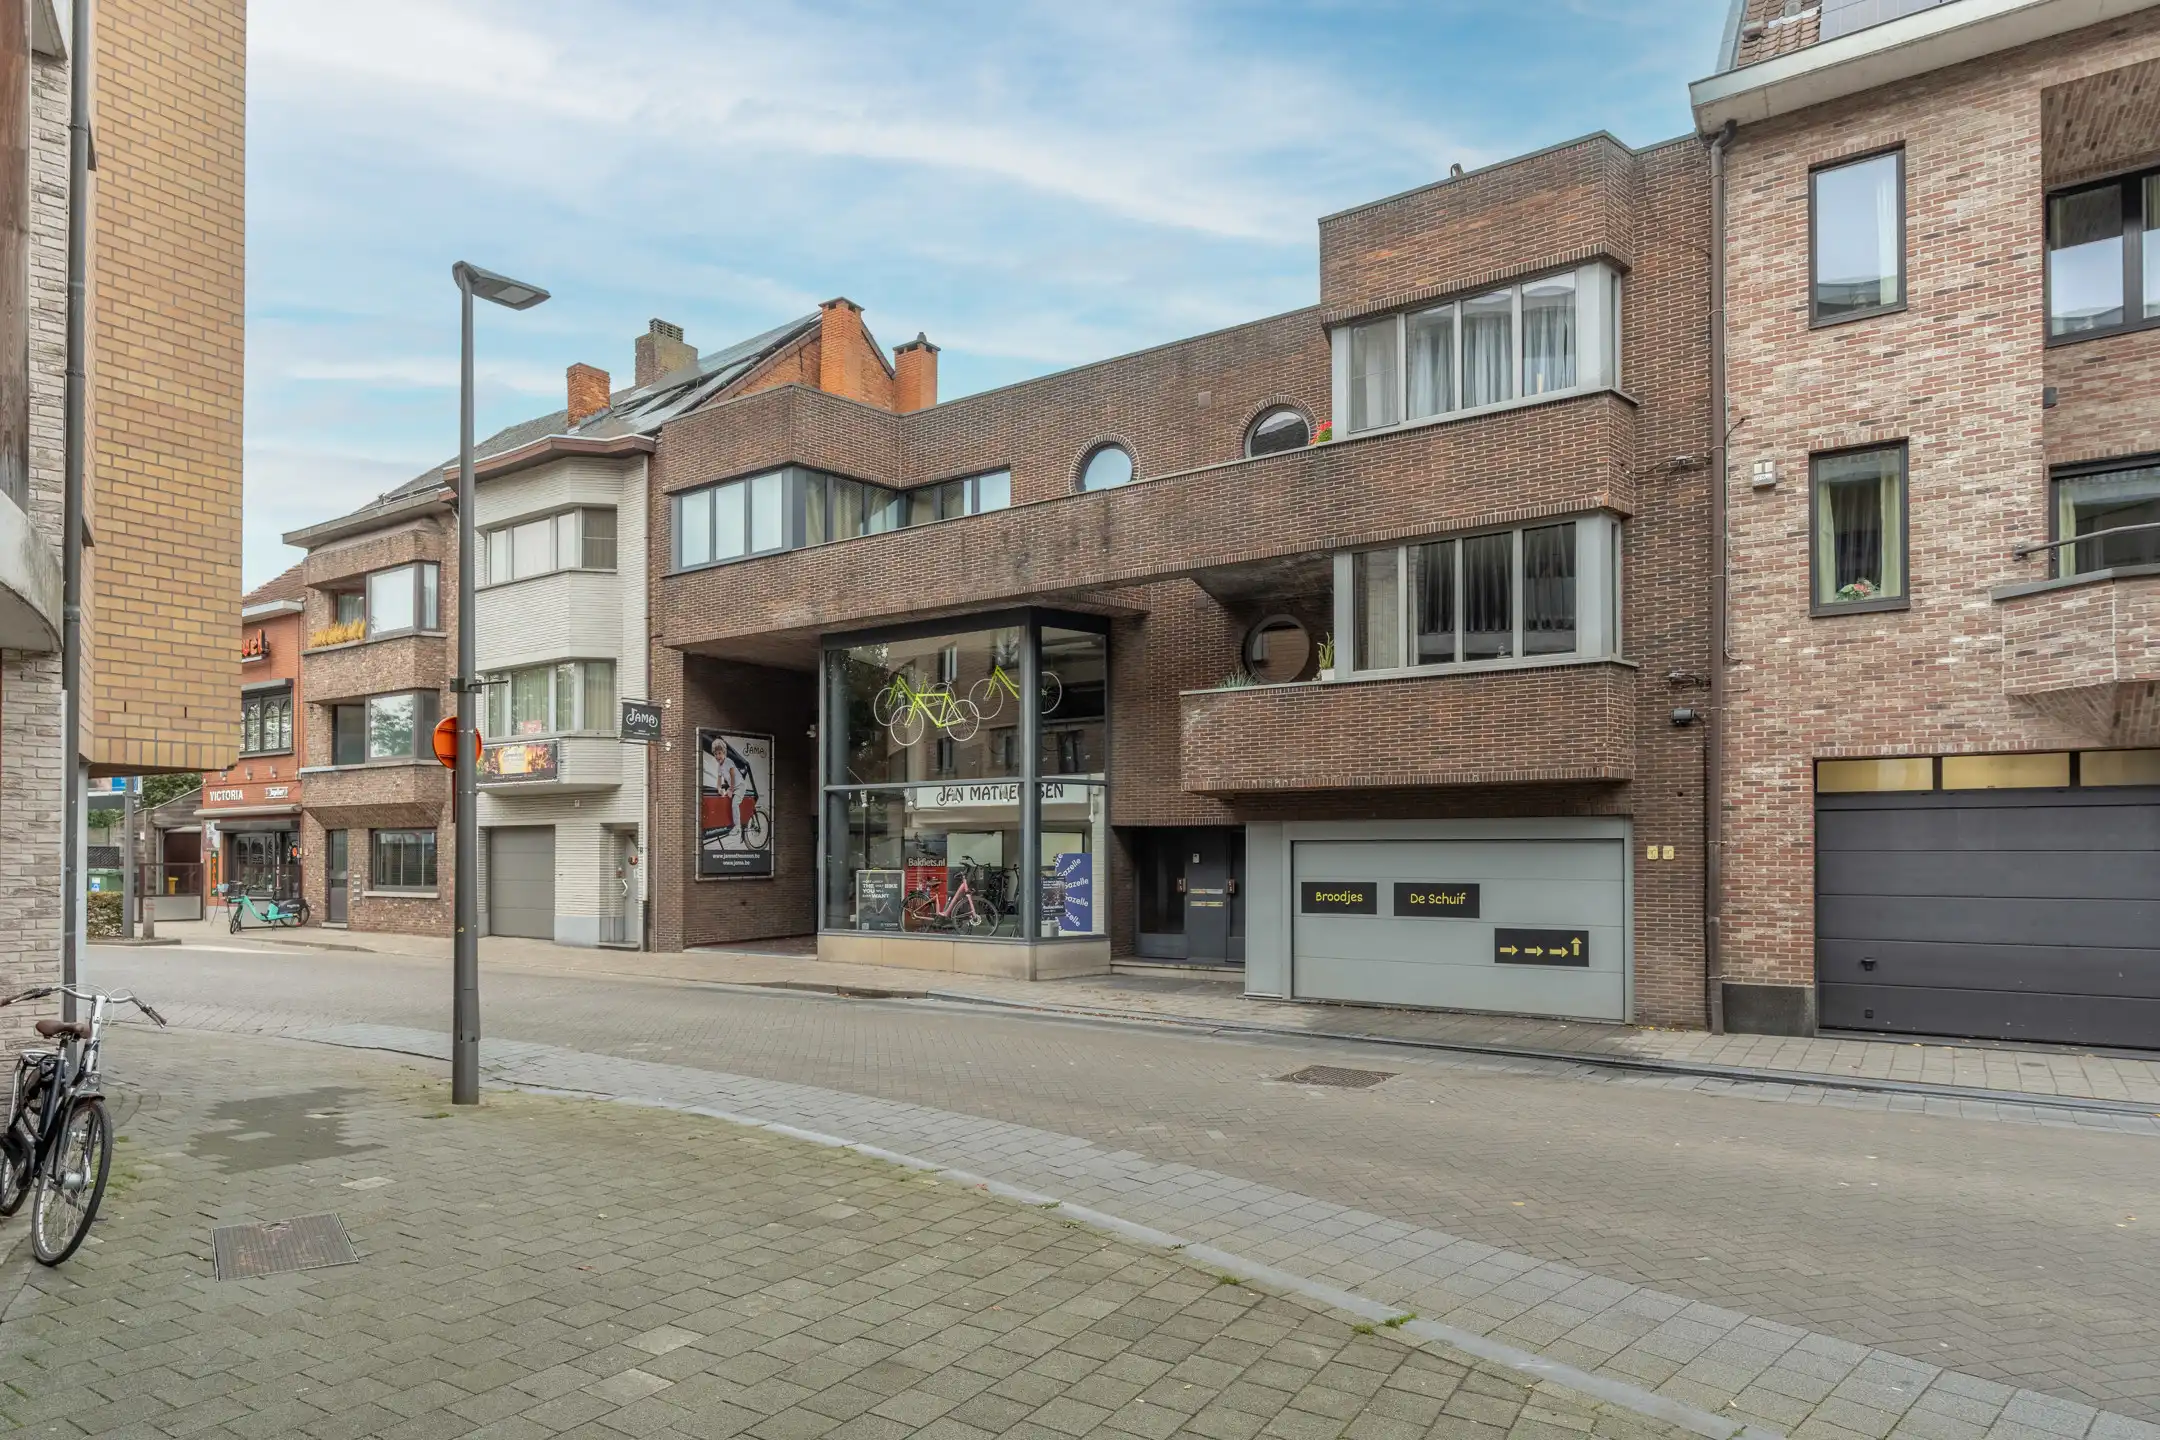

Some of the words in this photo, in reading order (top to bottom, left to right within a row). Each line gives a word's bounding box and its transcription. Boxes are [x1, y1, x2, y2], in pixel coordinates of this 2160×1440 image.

[626, 708, 658, 728] JAMA
[743, 742, 768, 758] JAMA
[209, 789, 244, 802] VICTORIA
[936, 785, 964, 806] JAN
[1315, 890, 1364, 905] Broodjes
[1410, 893, 1426, 904] De
[1428, 892, 1467, 905] Schuif
